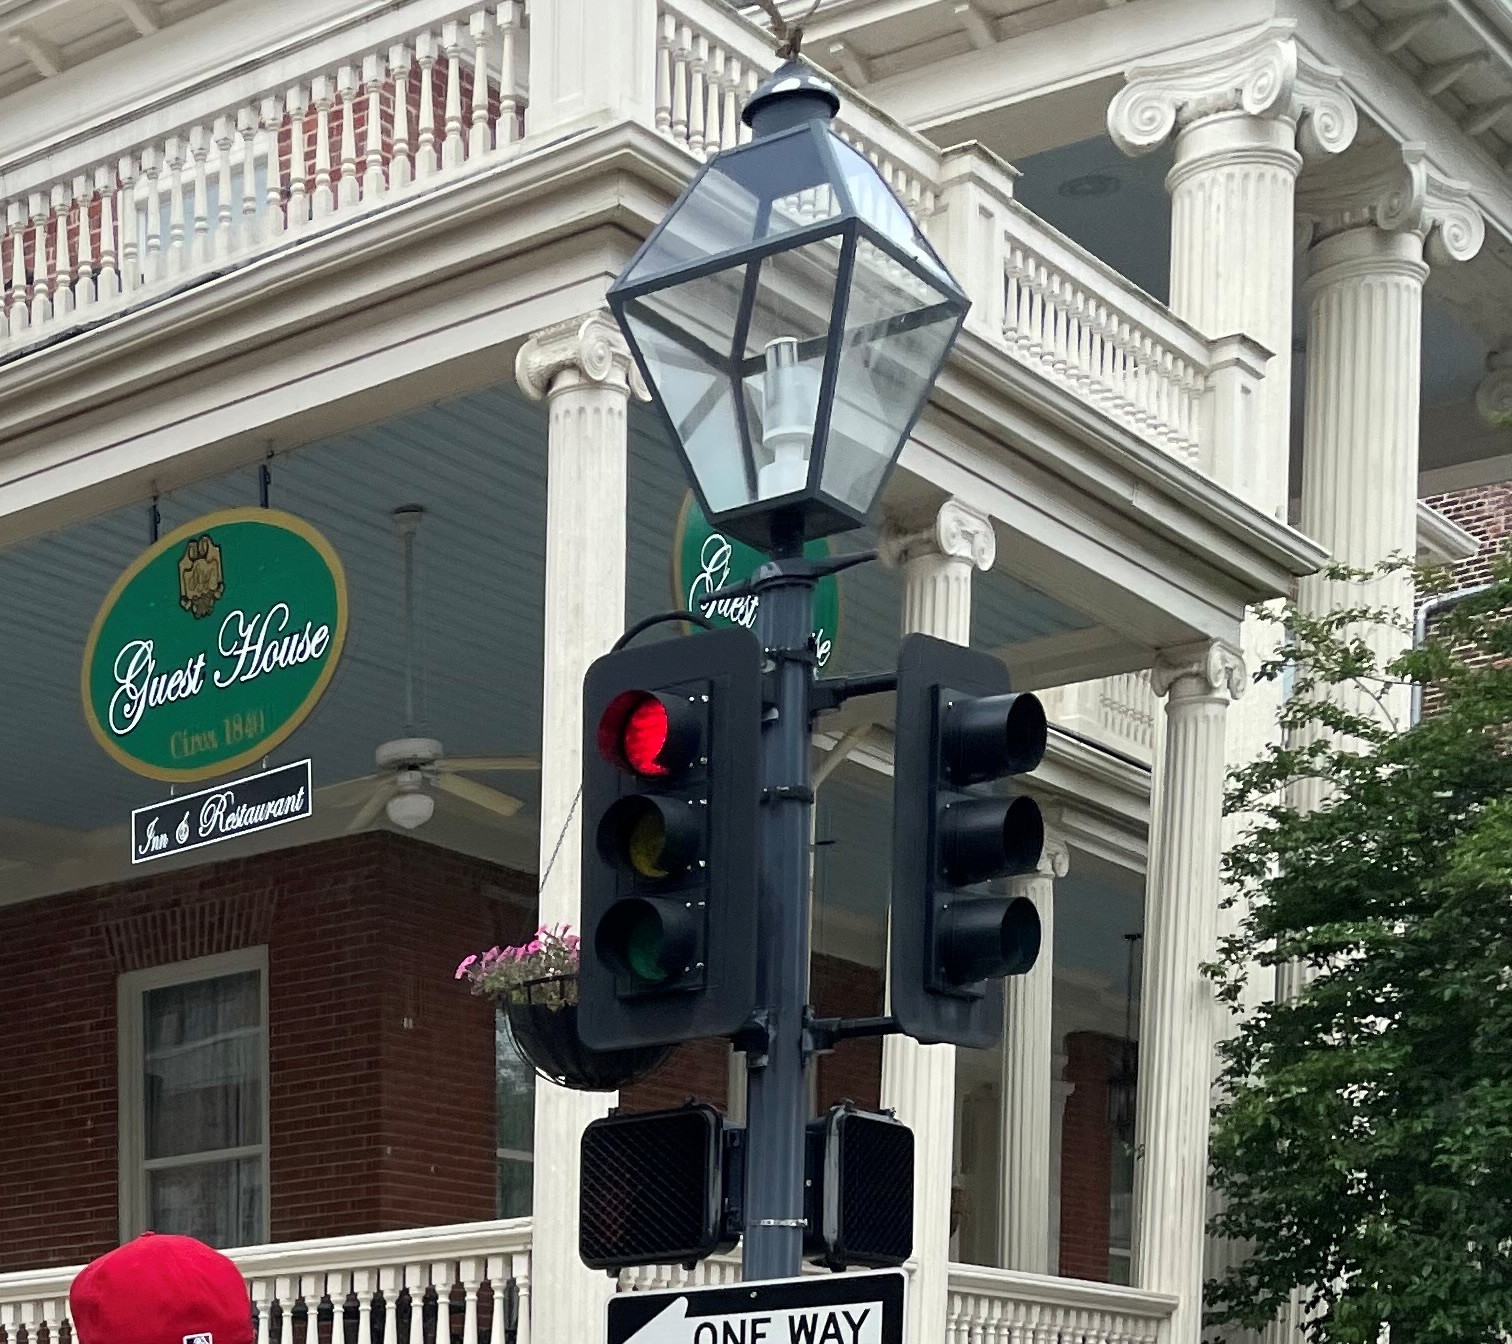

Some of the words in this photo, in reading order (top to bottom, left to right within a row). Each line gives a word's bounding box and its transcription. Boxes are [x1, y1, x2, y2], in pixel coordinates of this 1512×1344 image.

[109, 639, 206, 734] Guest
[214, 602, 330, 688] House
[138, 816, 169, 855] Inn
[198, 786, 305, 838] Restaurant
